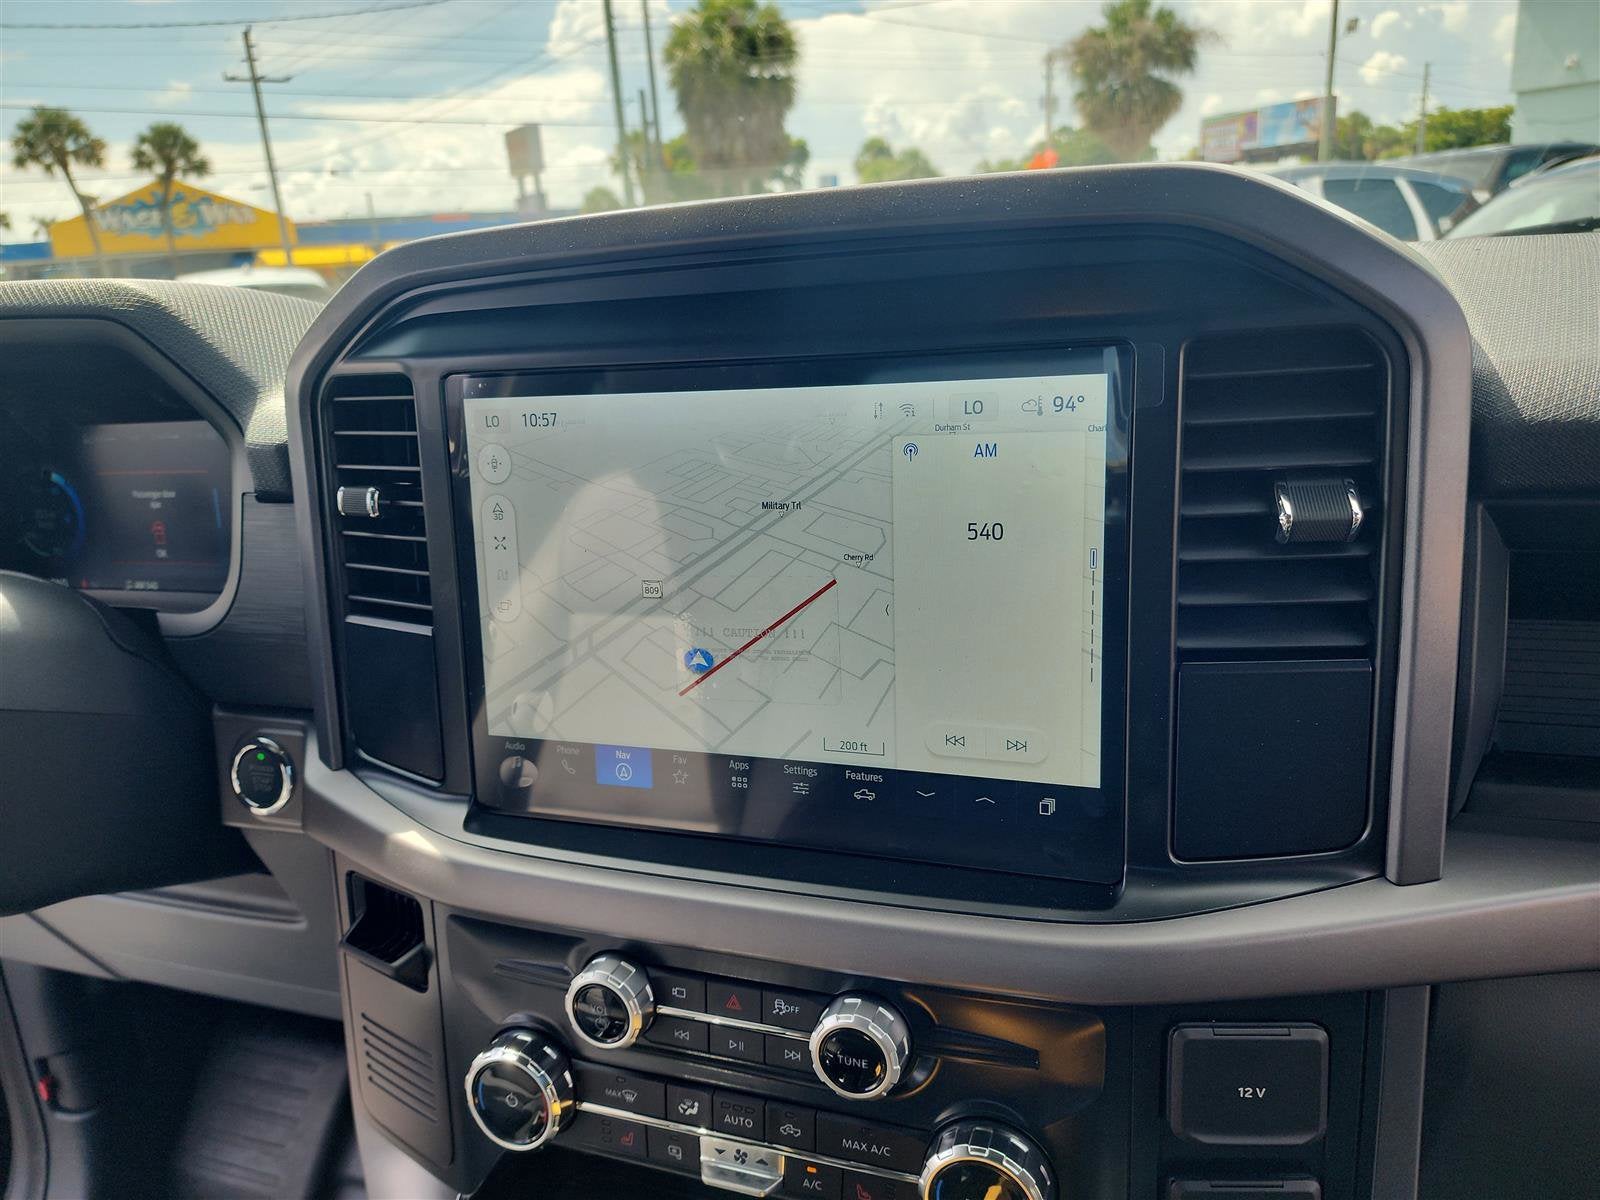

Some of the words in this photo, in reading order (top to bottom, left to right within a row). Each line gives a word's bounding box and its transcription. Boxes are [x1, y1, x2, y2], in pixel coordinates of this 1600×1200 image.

[964, 400, 984, 415] LO
[485, 415, 500, 428] LO
[521, 412, 557, 428] 10:57
[934, 423, 962, 432] Durham
[963, 423, 971, 431] St
[974, 443, 997, 458] AM
[761, 501, 790, 511] Military
[791, 501, 802, 510] Trl
[493, 513, 504, 521] 3D
[967, 522, 1004, 541] 540
[843, 553, 863, 562] Cherry
[864, 553, 874, 561] Rd
[644, 586, 660, 595] 809
[504, 741, 526, 751] Audio
[556, 744, 580, 755] Phone
[839, 740, 858, 751] 200
[860, 741, 868, 752] ft
[615, 750, 631, 760] Nav
[672, 754, 688, 765] Fav
[728, 760, 750, 771] Apps
[783, 764, 818, 778] Settings
[845, 770, 883, 783] Features
[784, 1005, 800, 1014] OFF
[837, 1054, 869, 1069] TUNE
[1237, 1087, 1253, 1098] 12
[1256, 1087, 1266, 1098] V
[724, 1114, 753, 1128] AUTO
[842, 1138, 868, 1152] MAX
[870, 1144, 891, 1156] A/C
[803, 1178, 822, 1191] A/C
